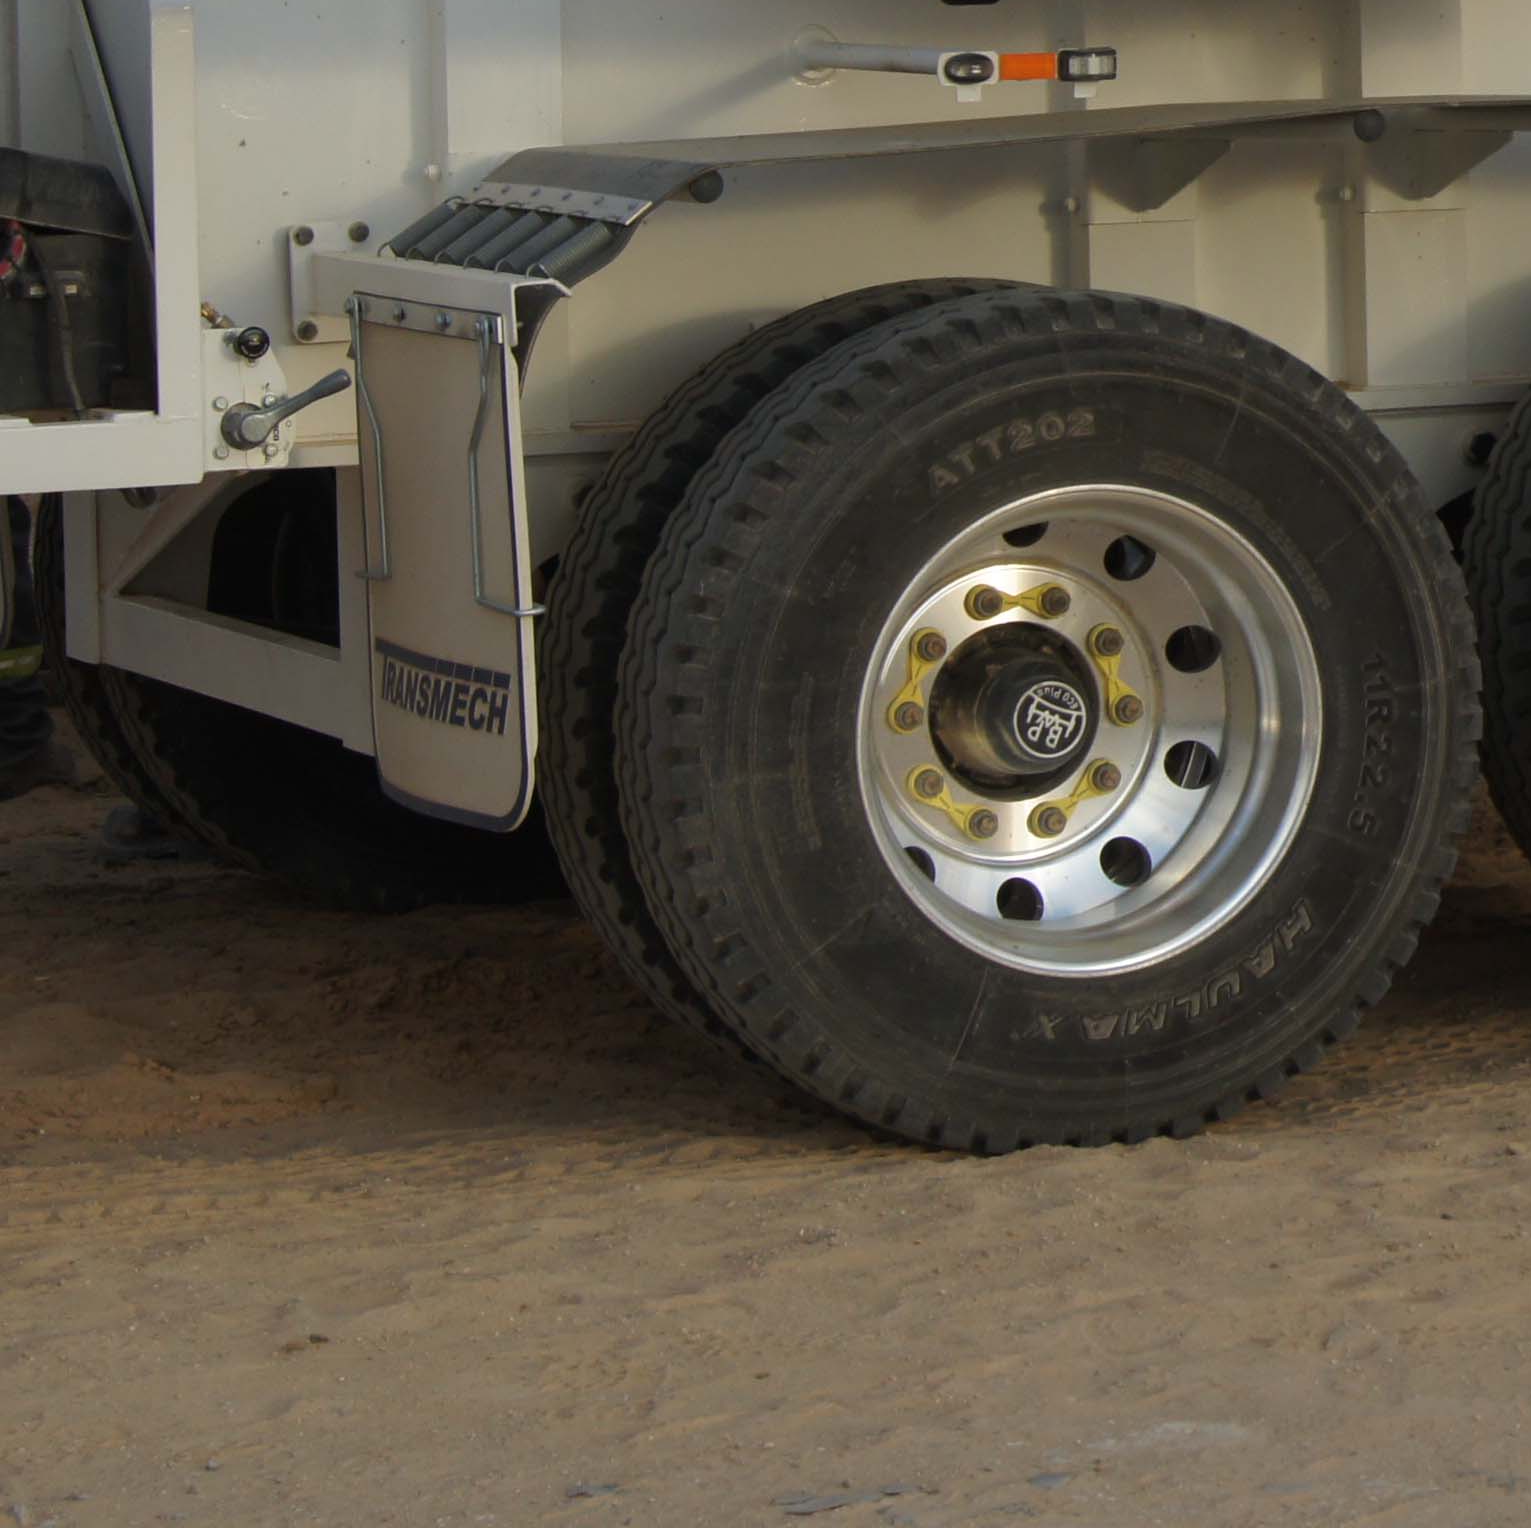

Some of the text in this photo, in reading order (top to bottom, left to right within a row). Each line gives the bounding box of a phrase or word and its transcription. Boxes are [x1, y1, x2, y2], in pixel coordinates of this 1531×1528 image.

[928, 407, 1096, 490] ATT202
[375, 637, 511, 736] TRANSMECH
[1343, 652, 1397, 838] 11R22.5
[1028, 898, 1314, 1041] HAULMAX
